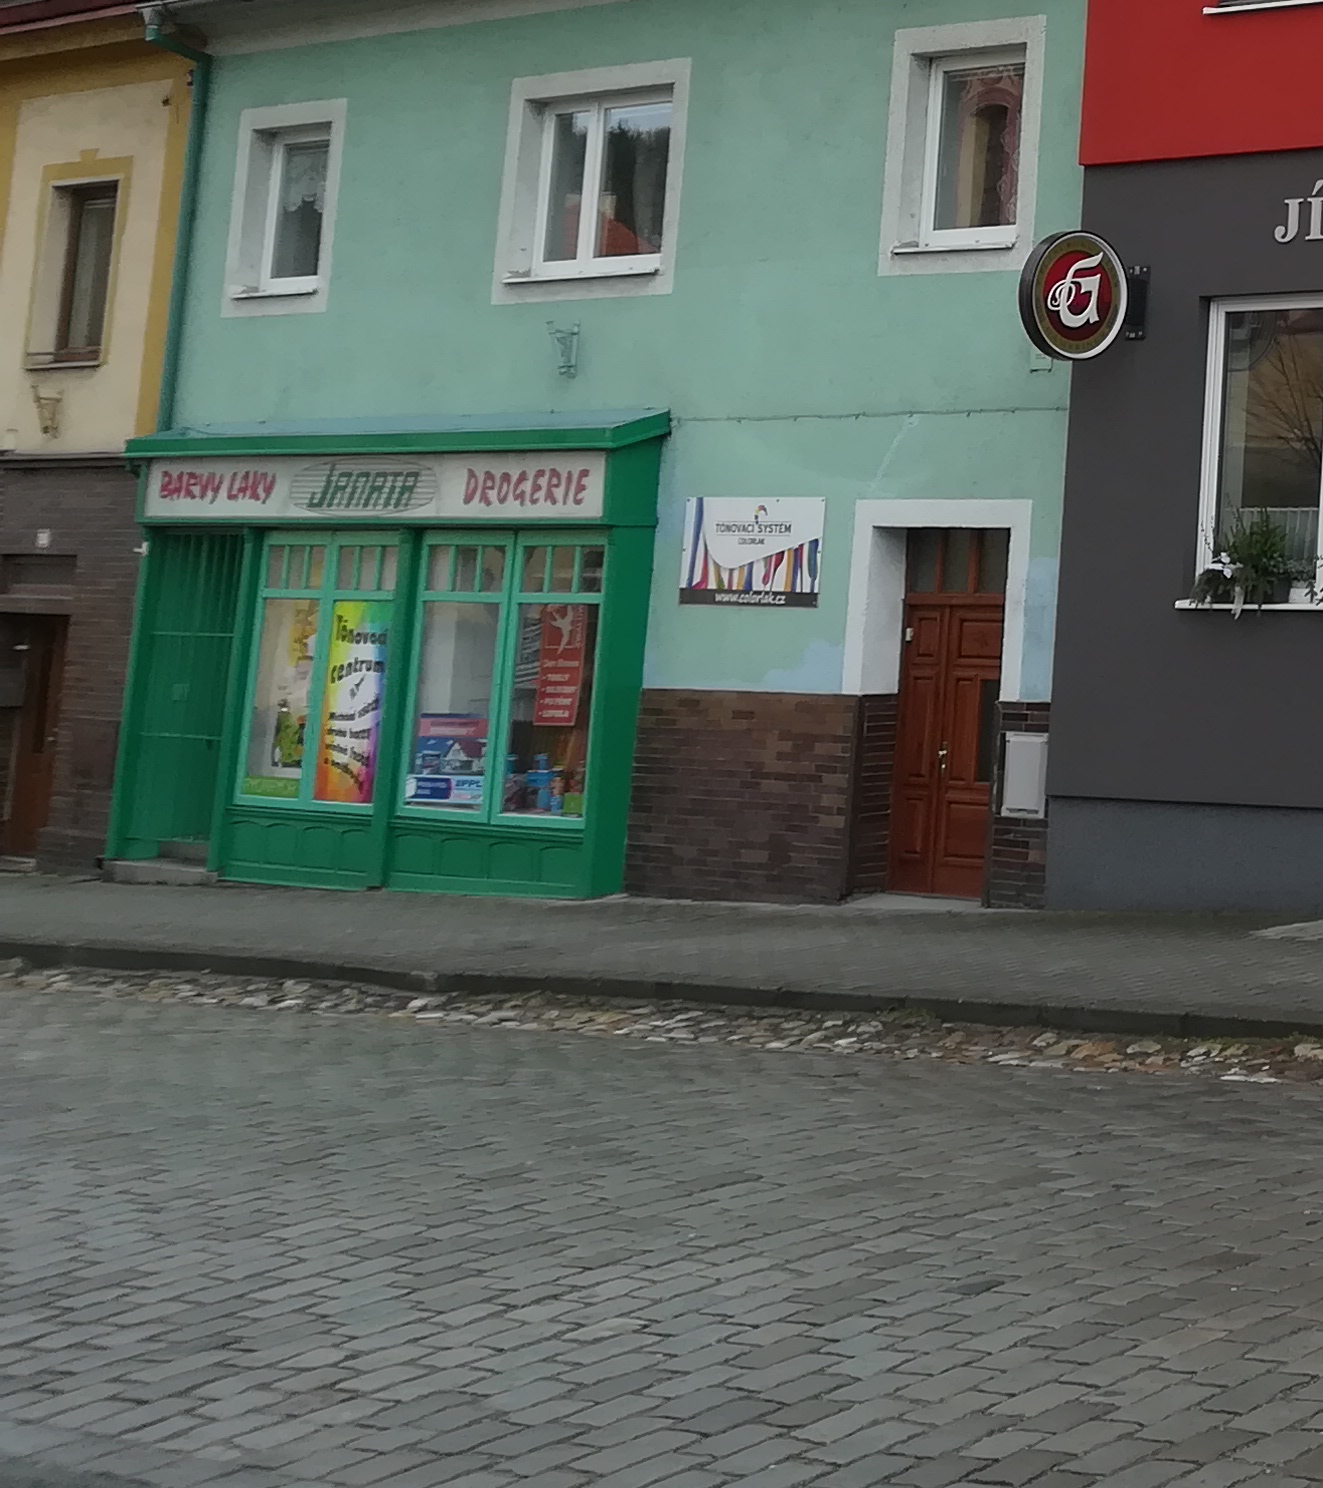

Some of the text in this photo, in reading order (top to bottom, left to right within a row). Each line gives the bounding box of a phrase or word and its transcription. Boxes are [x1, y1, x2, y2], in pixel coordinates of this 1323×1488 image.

[160, 469, 277, 505] BARVY LAKY
[462, 467, 591, 508] DROGERIE
[757, 522, 792, 534] SYSTÉM
[714, 591, 787, 605] www.colorlak.cz
